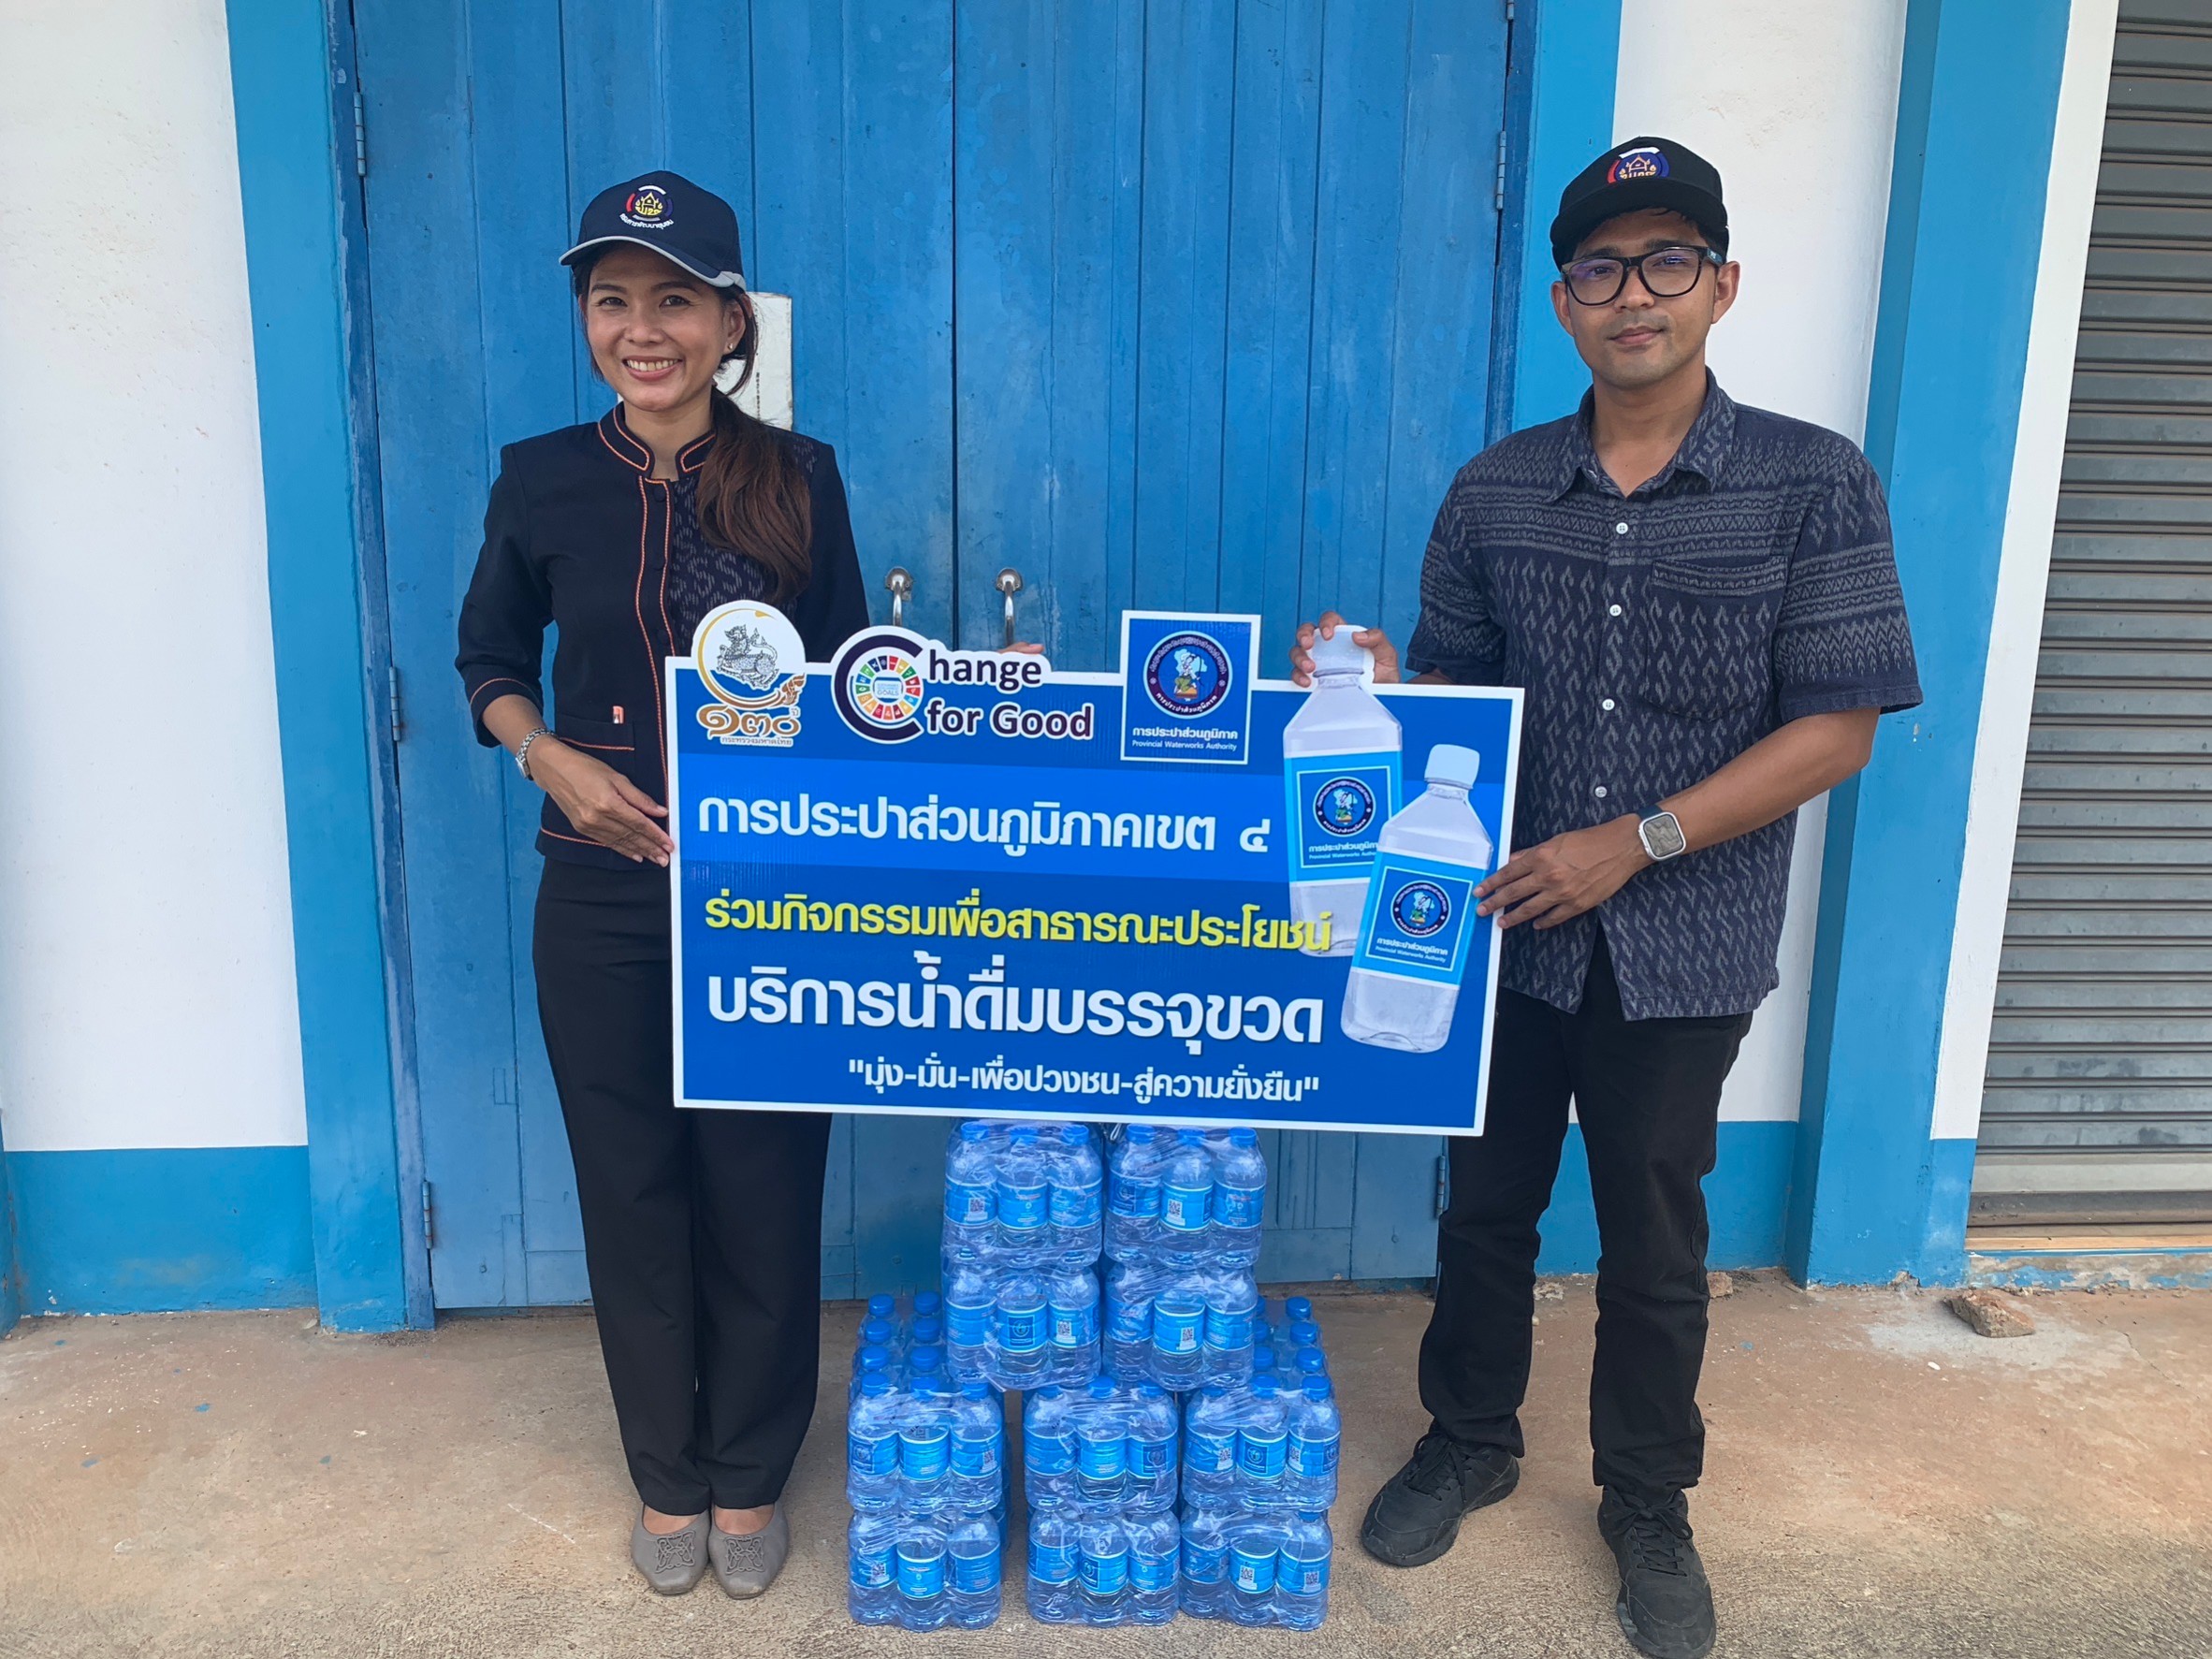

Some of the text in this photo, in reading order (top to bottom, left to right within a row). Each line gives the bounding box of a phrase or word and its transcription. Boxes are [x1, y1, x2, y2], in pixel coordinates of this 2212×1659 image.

[927, 701, 1092, 737] for Good
[1132, 727, 1238, 741] การประปาส่วนภูมิภาค
[1164, 741, 1204, 749] Waterworks
[1205, 743, 1237, 751] Authority
[699, 793, 1270, 856] การประปาส่วนภูมิภาคเขต ๔
[1308, 841, 1378, 852] การประปาส่วนภูมิภา
[705, 889, 1332, 953] ร่วมกิจกรรมเพื่อสาธารณะประโยชน์
[707, 950, 1324, 1056] บริการน้ำดื่มบรรจุขวด
[849, 1052, 1319, 1105] "มุ่ง-มั่น-เพื่อปวงชน-สู่ความยั่งยืน"
